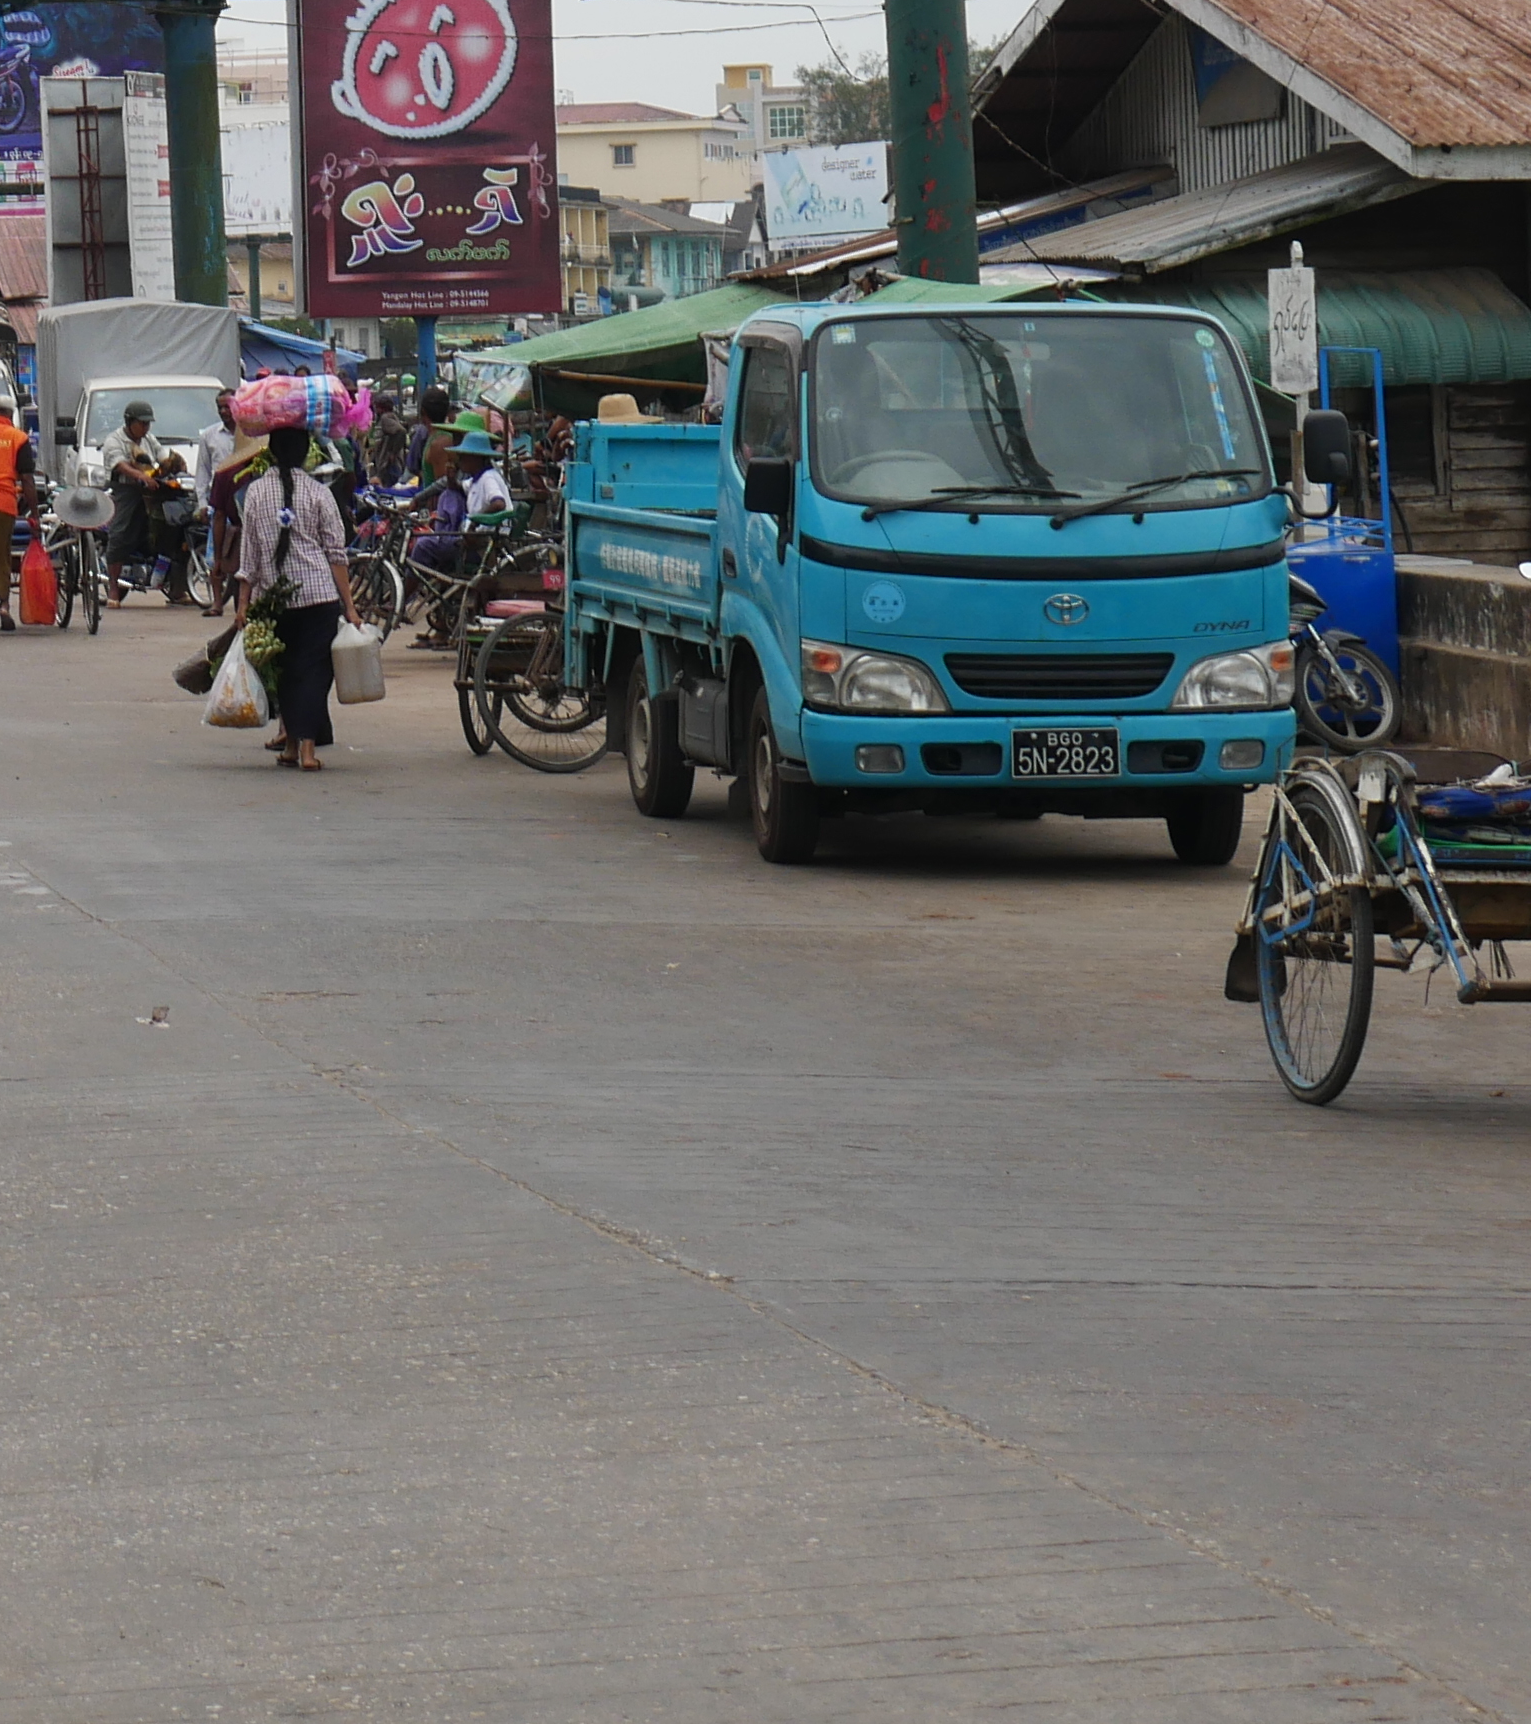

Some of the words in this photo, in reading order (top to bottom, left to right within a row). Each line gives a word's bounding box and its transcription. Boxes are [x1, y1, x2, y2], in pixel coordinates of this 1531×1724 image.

[821, 156, 861, 173] designer
[849, 168, 877, 181] water
[382, 291, 409, 301] Yangon
[411, 291, 426, 299] Hot
[428, 290, 444, 299] Line
[382, 301, 413, 310] Mandalay
[414, 301, 428, 309] Hot
[429, 300, 444, 309] Line
[1193, 619, 1250, 633] DYNA
[1047, 732, 1082, 746] BGO
[1017, 745, 1115, 775] 5N-2823
